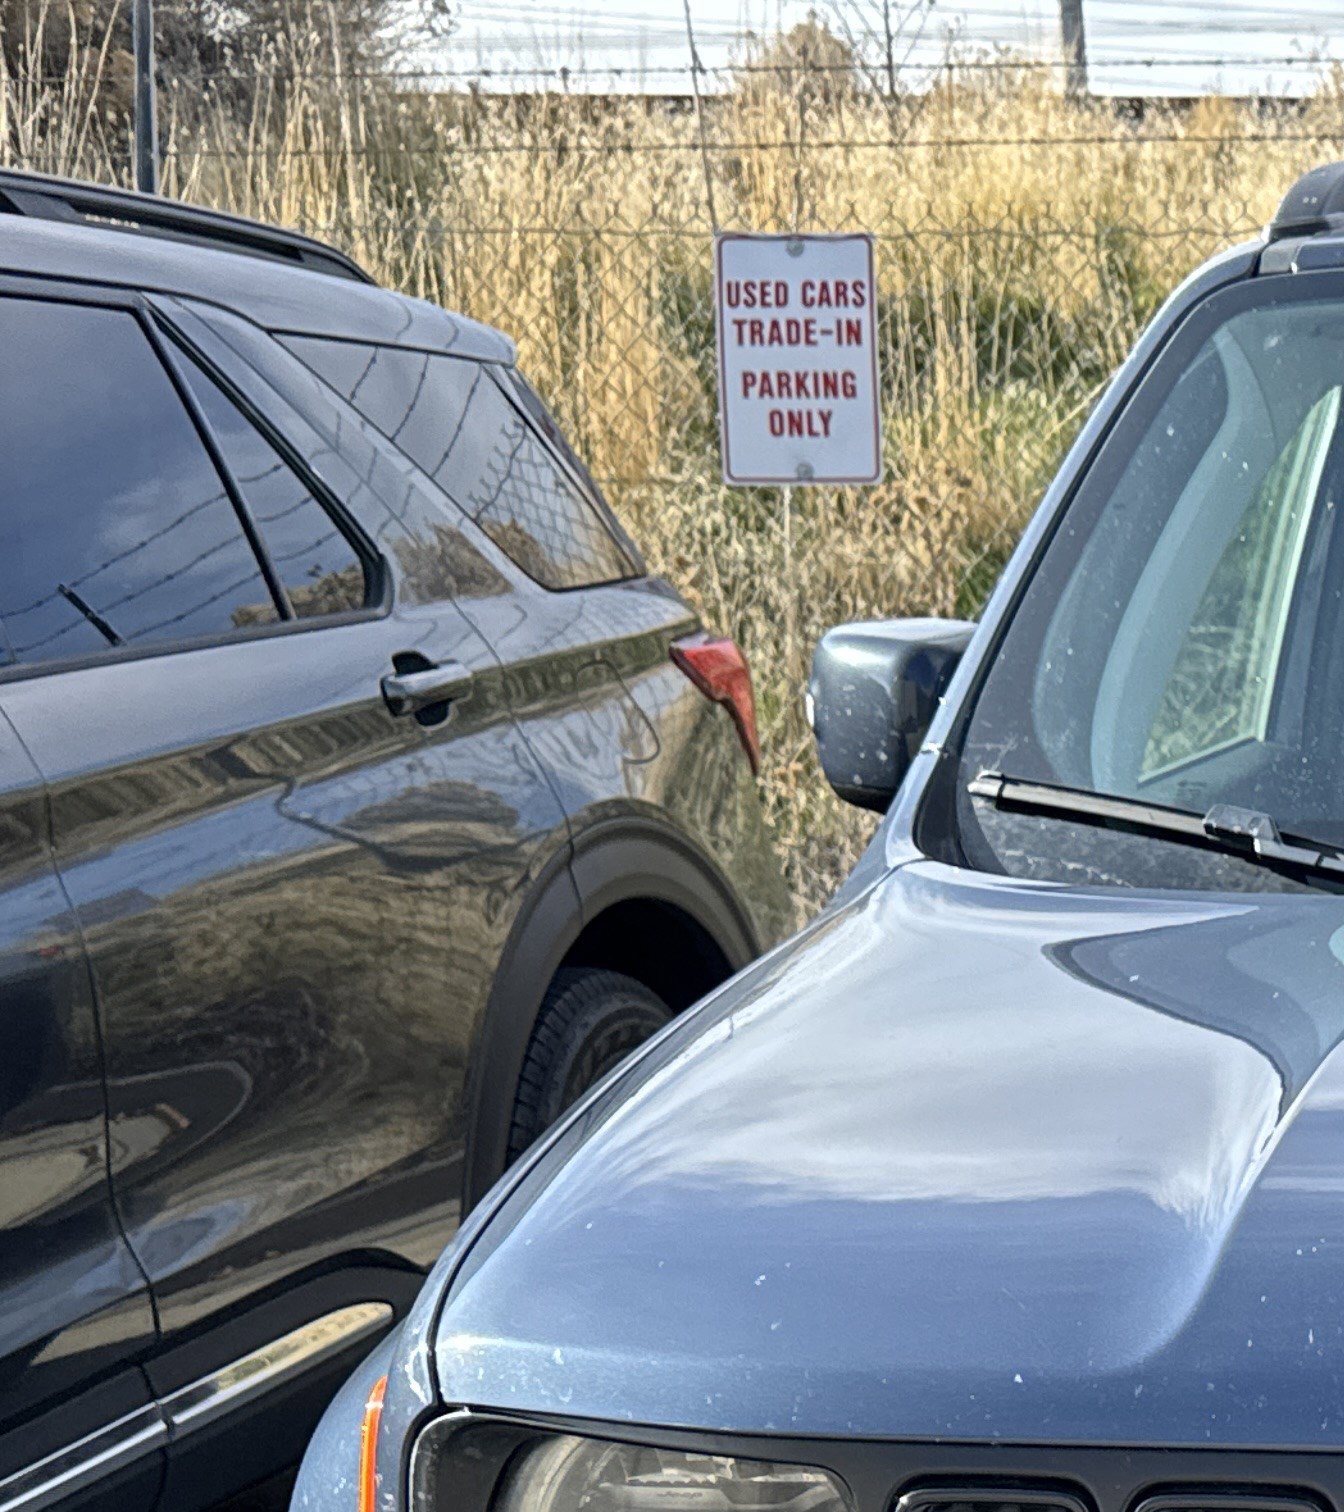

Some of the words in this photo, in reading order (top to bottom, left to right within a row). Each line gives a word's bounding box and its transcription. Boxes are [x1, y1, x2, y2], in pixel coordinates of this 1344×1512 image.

[725, 280, 789, 309] USED
[801, 280, 866, 309] CARS
[732, 318, 863, 347] TRADE-IN
[741, 370, 858, 400] PARKING
[767, 409, 833, 438] ONLY
